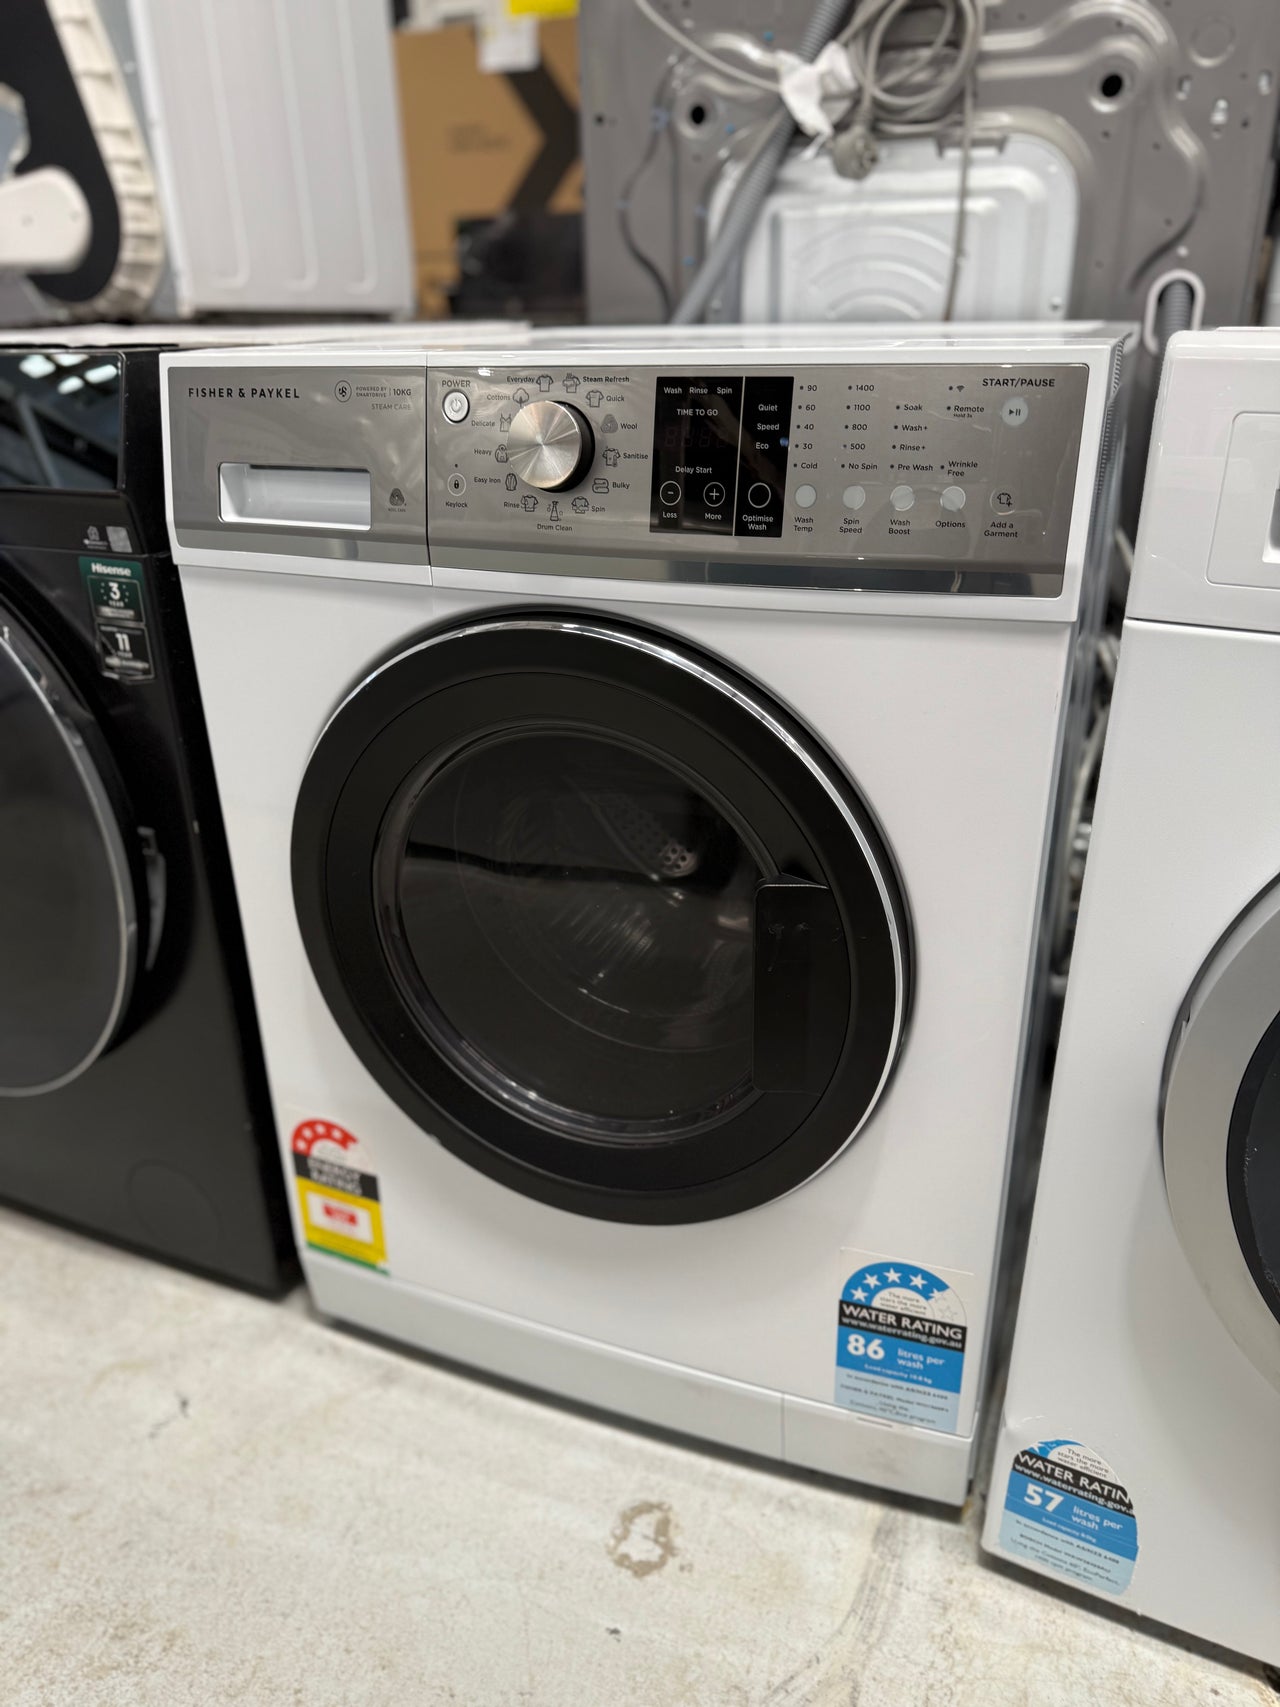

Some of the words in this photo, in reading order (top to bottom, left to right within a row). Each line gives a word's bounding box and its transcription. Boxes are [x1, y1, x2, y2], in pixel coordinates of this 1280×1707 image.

[717, 387, 732, 395] Spin
[982, 378, 1055, 387] START/PAUSE
[188, 388, 233, 398] FISHER
[238, 388, 246, 398] &
[251, 388, 300, 398] PAYKEL
[935, 520, 966, 528] Options
[91, 562, 131, 576] Hisense
[108, 582, 120, 600] 3
[115, 633, 130, 651] 11
[842, 1304, 897, 1326] WATER
[901, 1317, 962, 1340] RATING
[841, 1317, 962, 1348] www.waterrating.gov.au
[847, 1334, 885, 1360] 86
[897, 1348, 924, 1362] litres
[926, 1355, 945, 1366] per
[897, 1358, 924, 1370] wash
[1058, 1457, 1078, 1467] water
[1058, 1452, 1073, 1460] stars
[1090, 1463, 1109, 1473] more
[1067, 1448, 1080, 1457] The
[1082, 1455, 1101, 1465] more
[1017, 1452, 1074, 1484] WATER
[1023, 1483, 1064, 1513] 57
[1071, 1515, 1099, 1531] wash
[1073, 1505, 1100, 1523] litres
[1103, 1517, 1123, 1531] per
